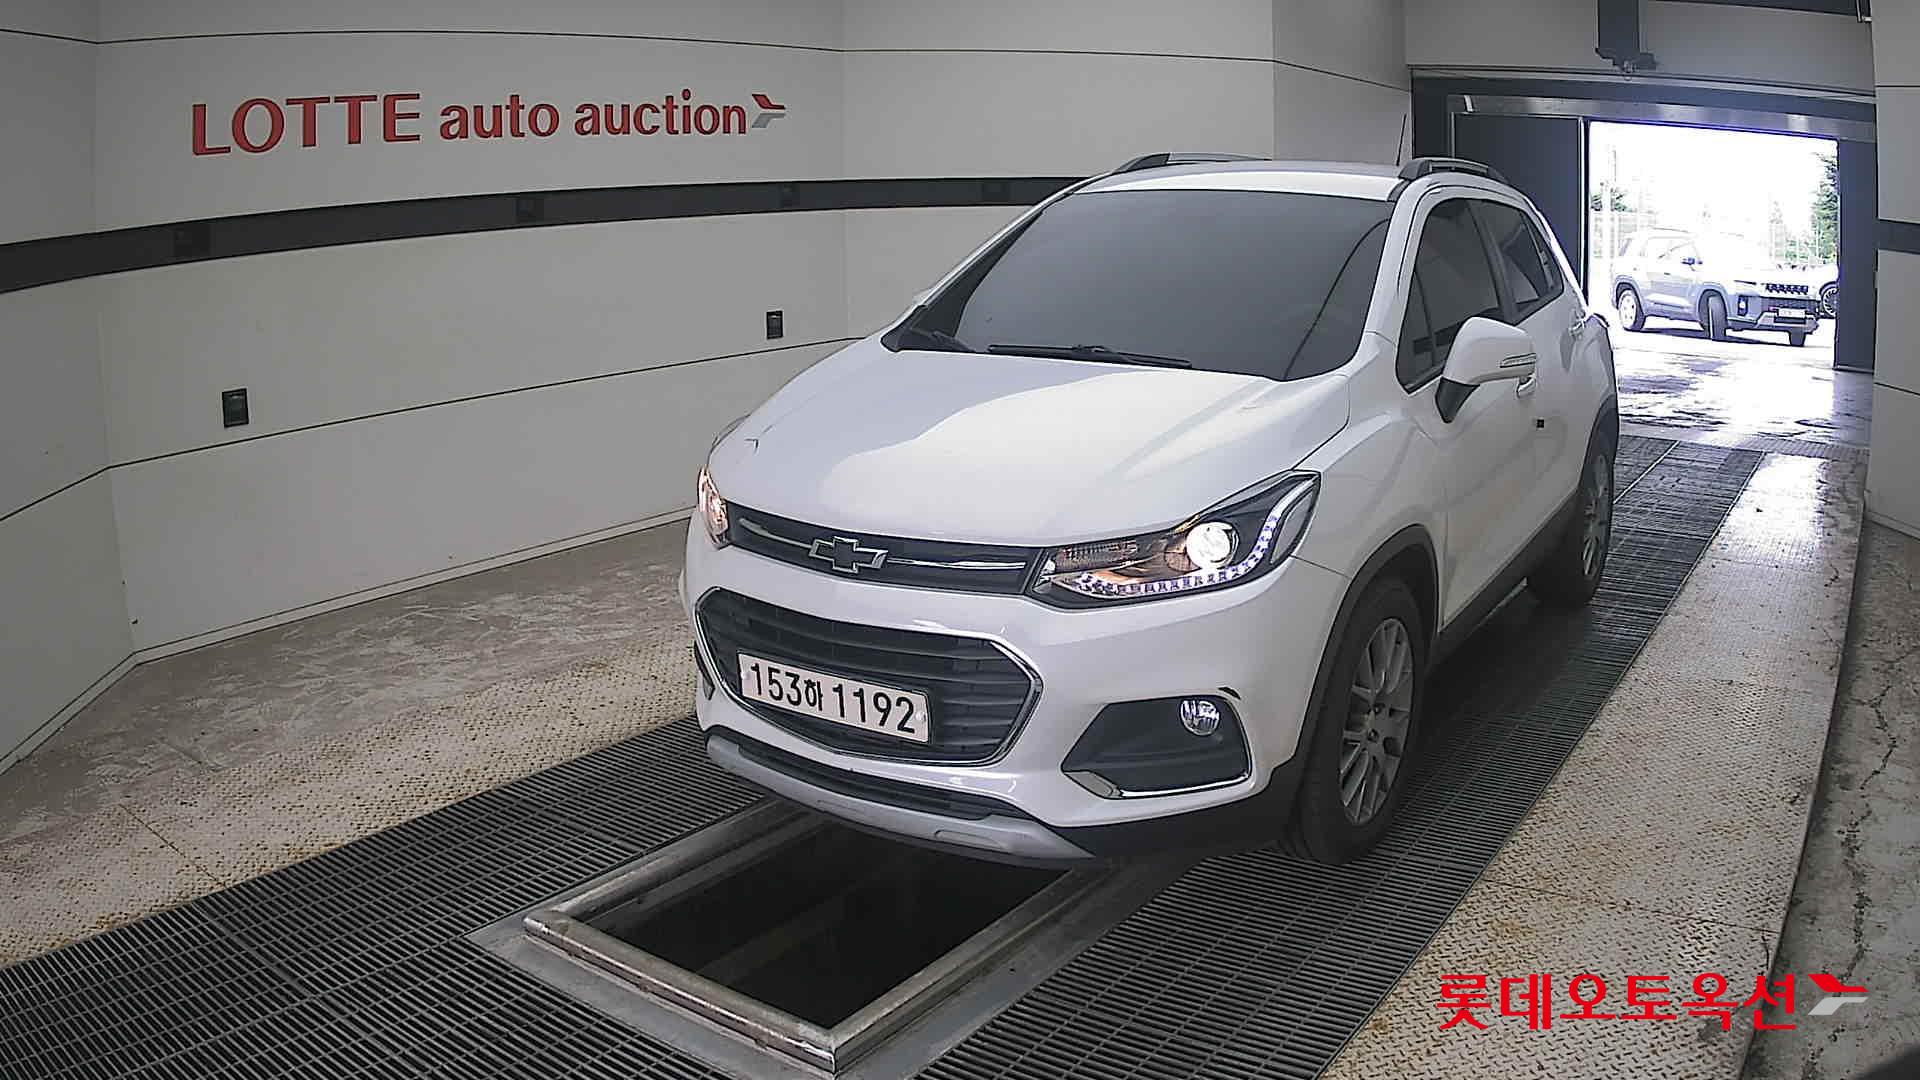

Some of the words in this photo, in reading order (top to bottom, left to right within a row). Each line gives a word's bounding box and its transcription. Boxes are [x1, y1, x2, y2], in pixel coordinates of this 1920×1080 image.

[191, 92, 421, 156] LOTTE
[439, 93, 561, 140] auto
[575, 88, 748, 136] auction
[750, 662, 824, 712] 153하
[832, 683, 915, 734] 1192
